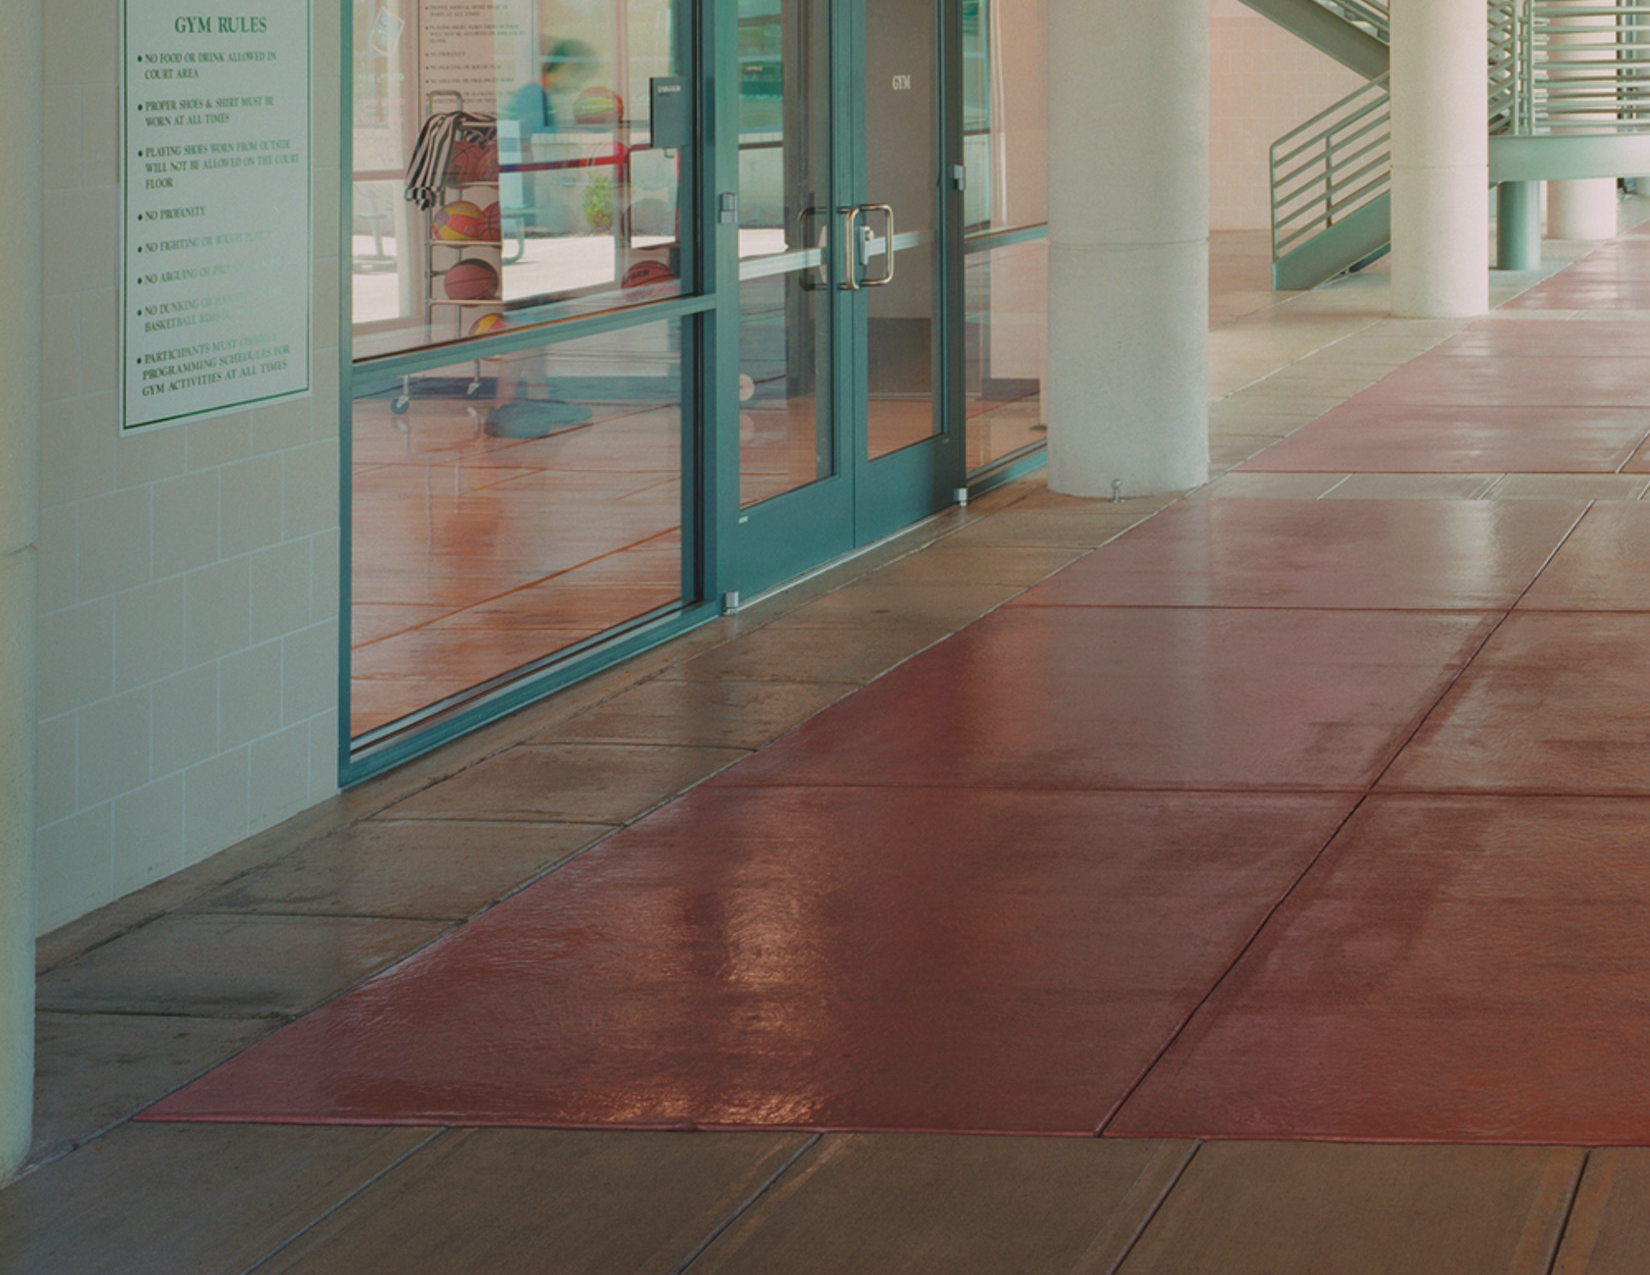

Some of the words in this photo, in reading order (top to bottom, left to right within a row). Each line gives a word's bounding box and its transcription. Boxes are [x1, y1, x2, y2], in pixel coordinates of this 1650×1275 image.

[174, 15, 212, 33] GYM
[218, 16, 268, 33] RULES
[145, 53, 158, 64] NO
[160, 53, 182, 64] FOOD
[184, 52, 196, 63] OR
[198, 52, 225, 63] DRINK
[227, 51, 265, 62] ALLOWED
[267, 50, 277, 61] IN
[144, 69, 173, 80] COURT
[177, 68, 199, 79] AREA
[145, 100, 176, 112] PROPER
[179, 99, 203, 110] SHOES
[205, 98, 213, 109] &
[216, 97, 239, 108] SHIRT
[241, 96, 263, 107] MUST
[145, 116, 172, 127] WORN
[173, 115, 184, 126] AT
[187, 114, 202, 125] ALL
[205, 113, 230, 124] TIMES
[145, 145, 181, 158] PLAYING
[183, 144, 208, 155] SHOES
[209, 142, 234, 154] WORN
[236, 140, 258, 152] FROM
[145, 161, 168, 173] WILL
[170, 160, 187, 172] NOT
[189, 159, 200, 171] BE
[202, 157, 241, 170] ALLOWED
[242, 156, 255, 167] ON
[257, 154, 273, 166] THE
[145, 177, 174, 190] FLOOR
[145, 209, 158, 220] NO
[160, 205, 206, 220] PROFANITY
[145, 241, 158, 252] NO
[160, 237, 200, 252] FIGHTING
[145, 272, 158, 283] NO
[145, 304, 158, 315] NO
[160, 298, 199, 315] DUNKING
[145, 314, 197, 332] BASKETBALL
[145, 343, 211, 364] PARTICIPANTS
[143, 357, 217, 380] PROGRAMMING
[219, 347, 272, 368] SCHEDULES
[142, 382, 165, 397] GYM
[168, 372, 222, 392] ACTIVITIES
[224, 369, 236, 381] AT
[239, 365, 257, 377] ALL
[260, 358, 288, 374] TIMES
